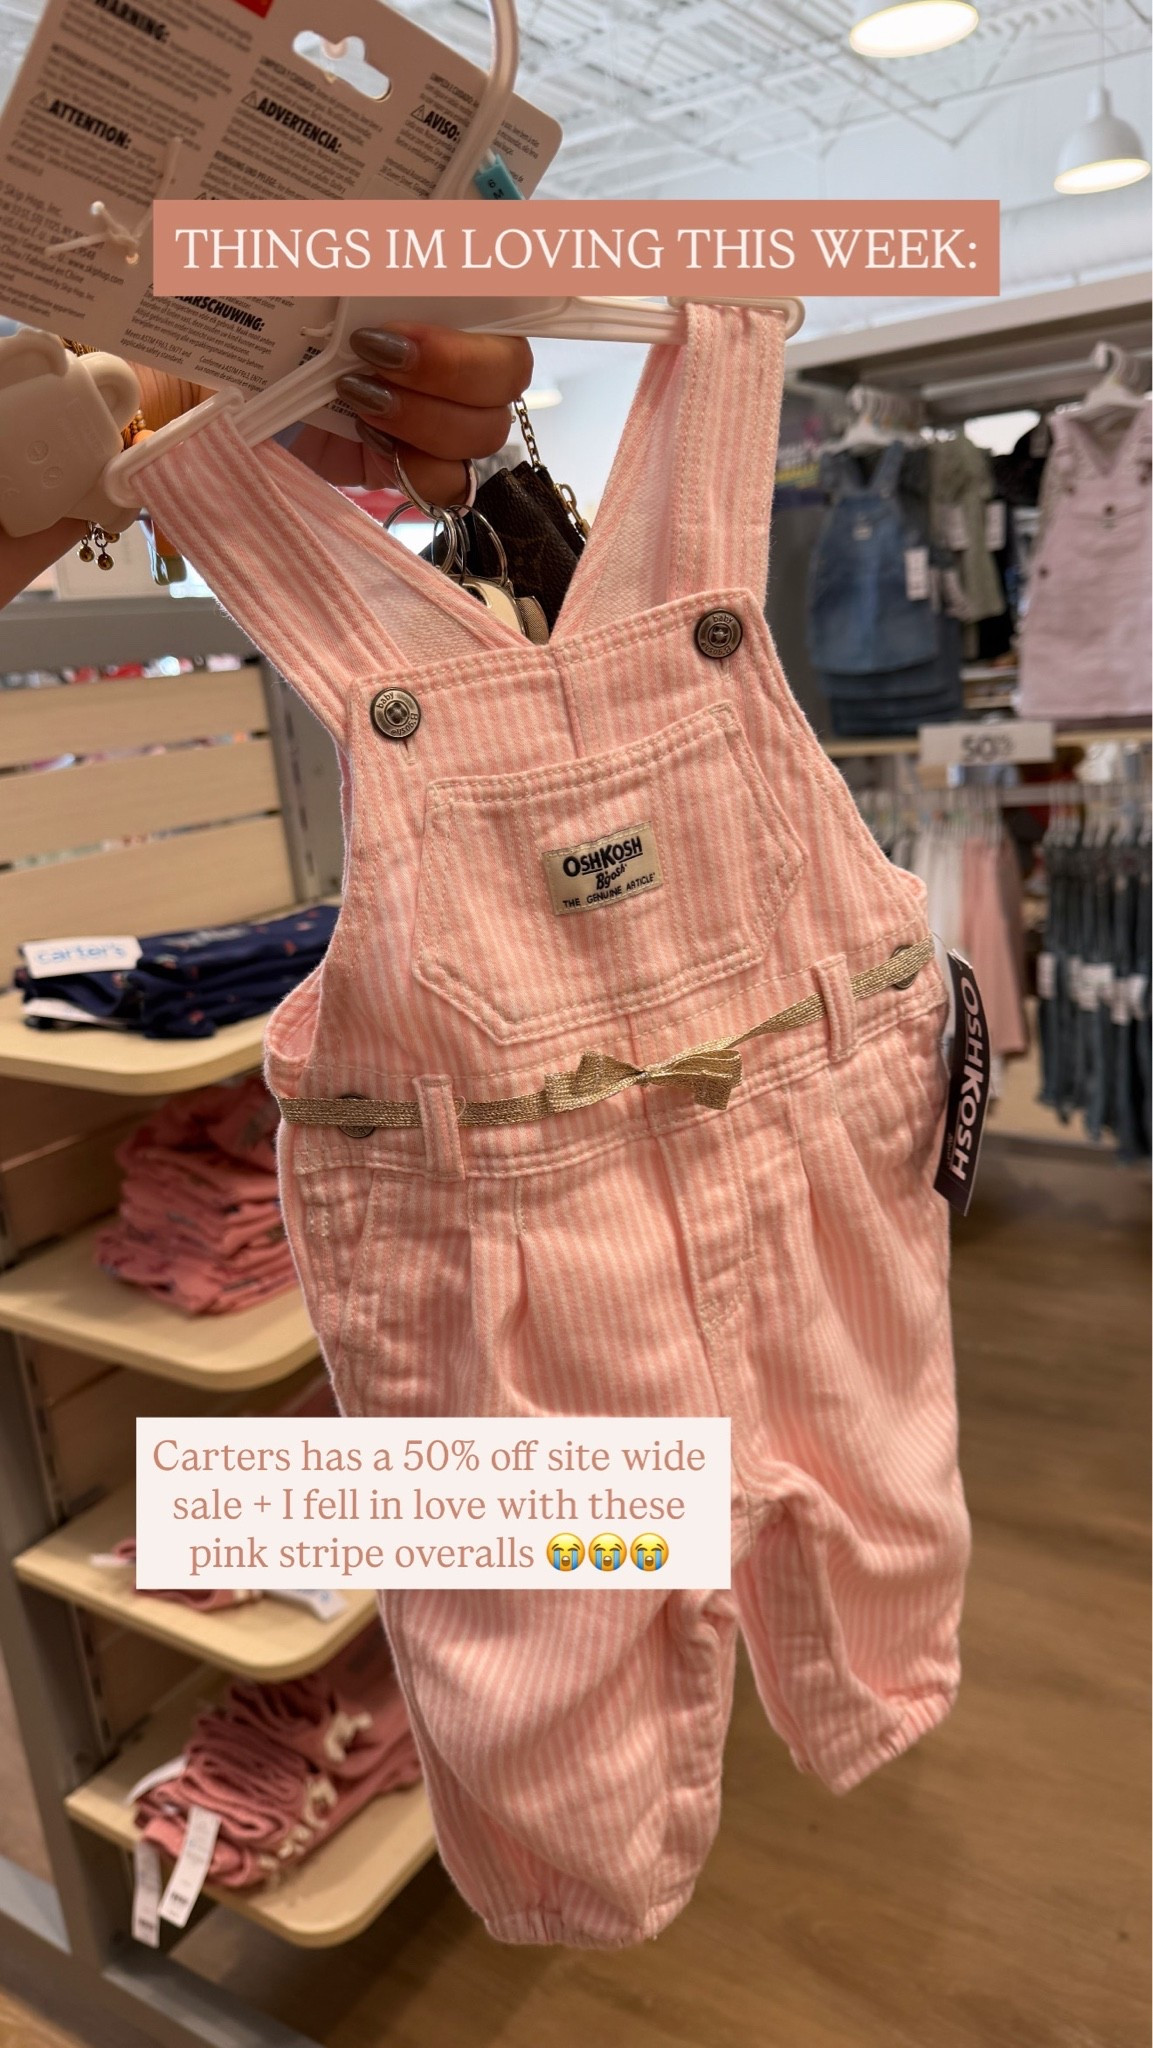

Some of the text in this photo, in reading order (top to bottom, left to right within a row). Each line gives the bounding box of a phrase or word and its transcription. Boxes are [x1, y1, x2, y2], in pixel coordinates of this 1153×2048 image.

[48, 97, 133, 150] ATTENTION:
[256, 96, 343, 155] ADVERTENCIA:
[421, 109, 463, 142] AVISO:
[714, 615, 733, 624] baby
[376, 691, 393, 708] baby
[563, 836, 643, 877] OSHKOSH
[563, 898, 580, 909] THE
[587, 886, 622, 903] GENUINE
[952, 976, 983, 1181] OSHKOSH
